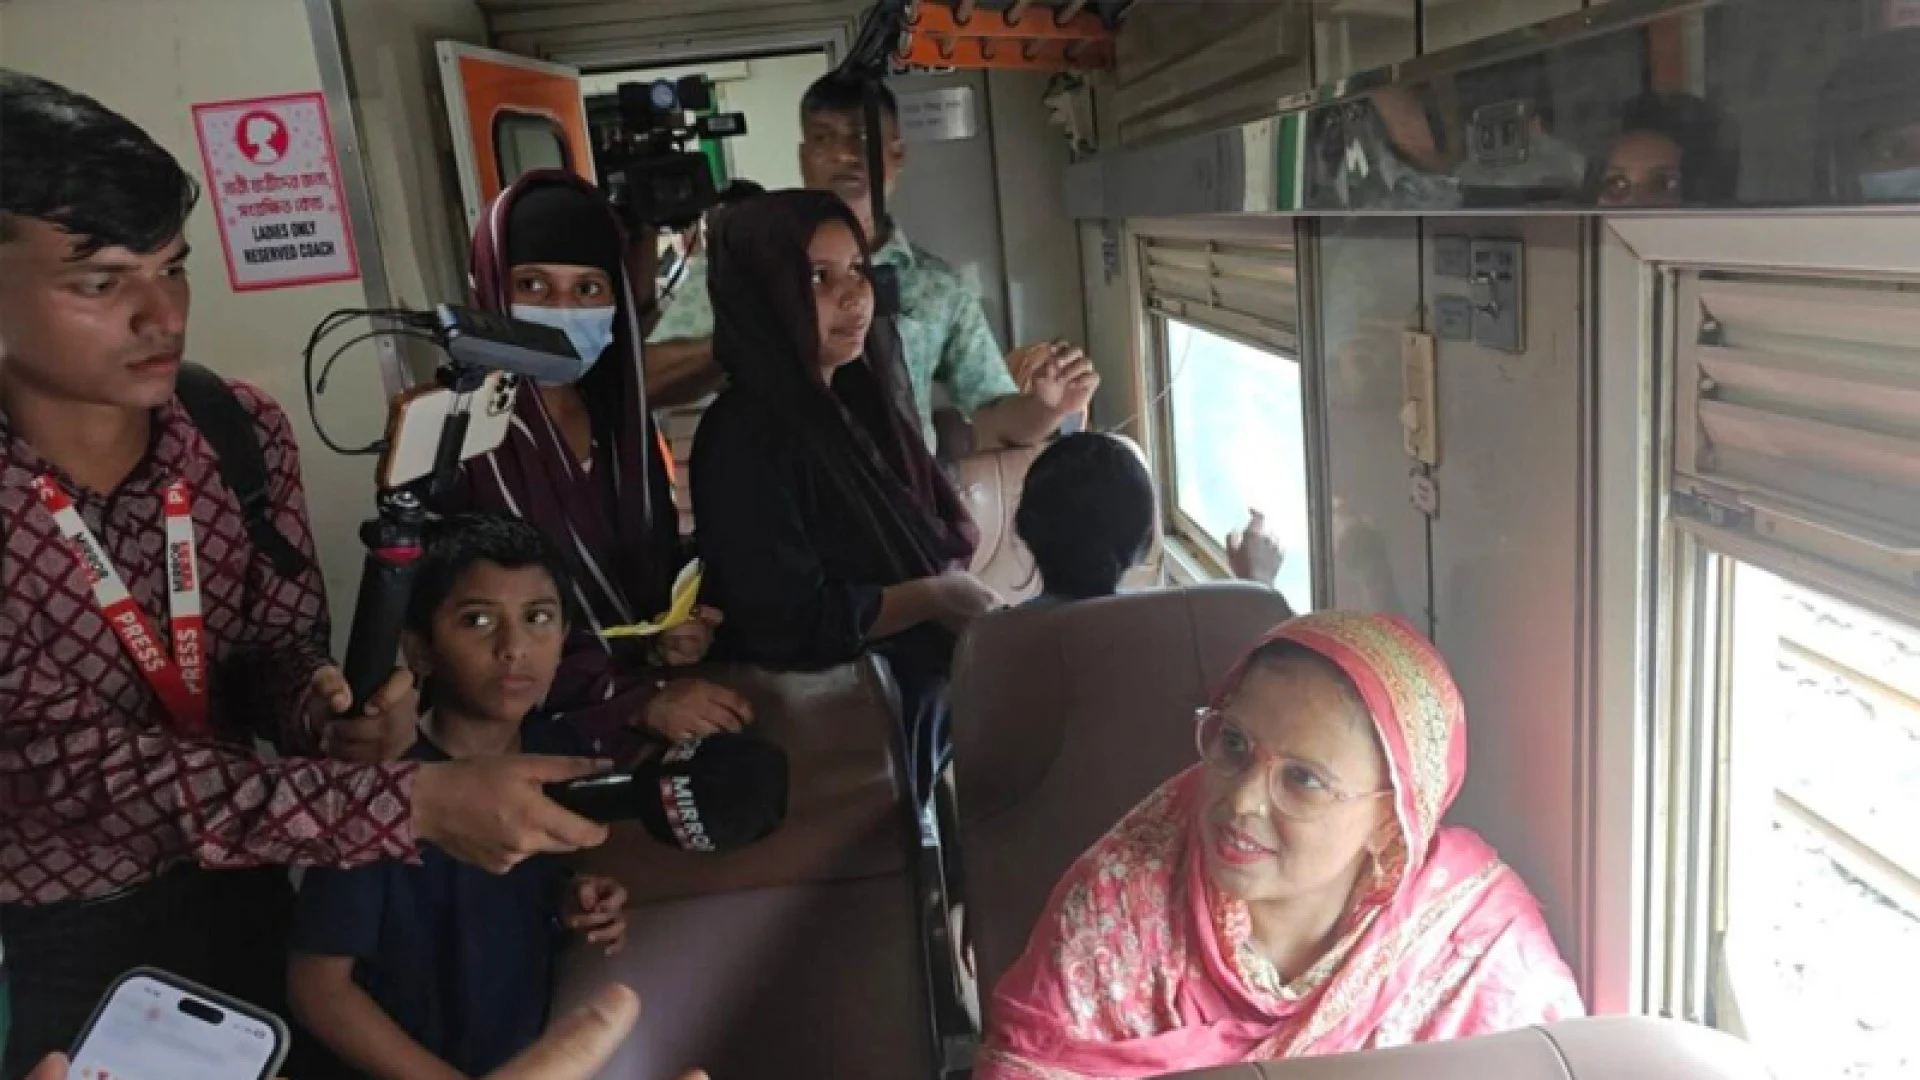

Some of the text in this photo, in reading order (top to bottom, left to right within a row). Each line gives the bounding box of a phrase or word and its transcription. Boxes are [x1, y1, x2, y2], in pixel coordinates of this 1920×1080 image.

[252, 221, 316, 241] LADIES ONLY
[243, 241, 336, 264] RESERVED COACH
[113, 611, 166, 672] PRESS
